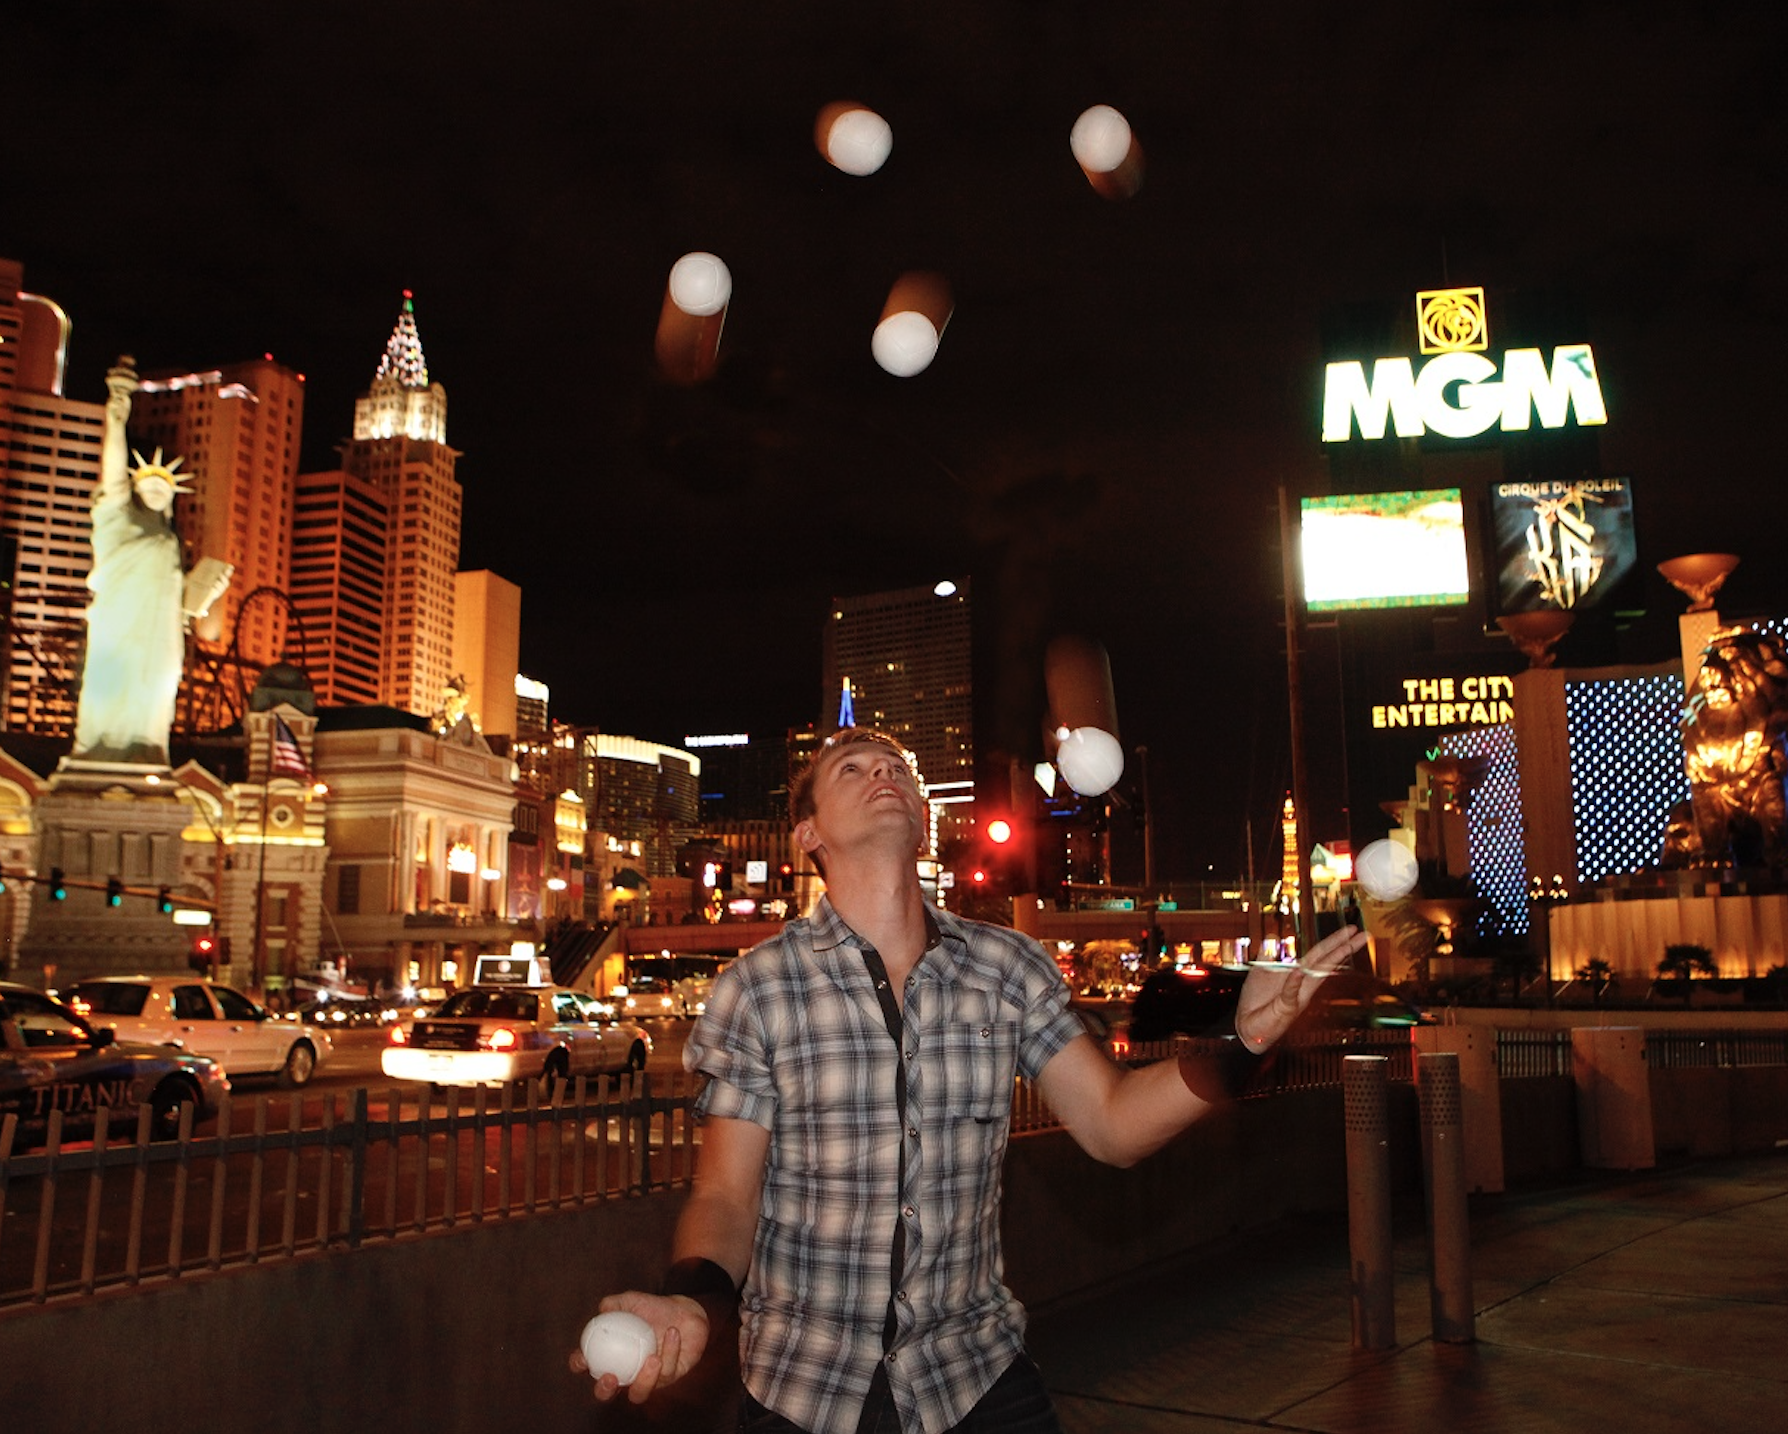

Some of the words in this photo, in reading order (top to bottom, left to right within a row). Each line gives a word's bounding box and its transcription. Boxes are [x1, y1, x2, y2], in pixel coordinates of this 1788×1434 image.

[1322, 344, 1607, 442] MGM
[1552, 481, 1572, 494] DU
[1403, 677, 1454, 701] THE
[32, 1080, 145, 1115] TITANIC
